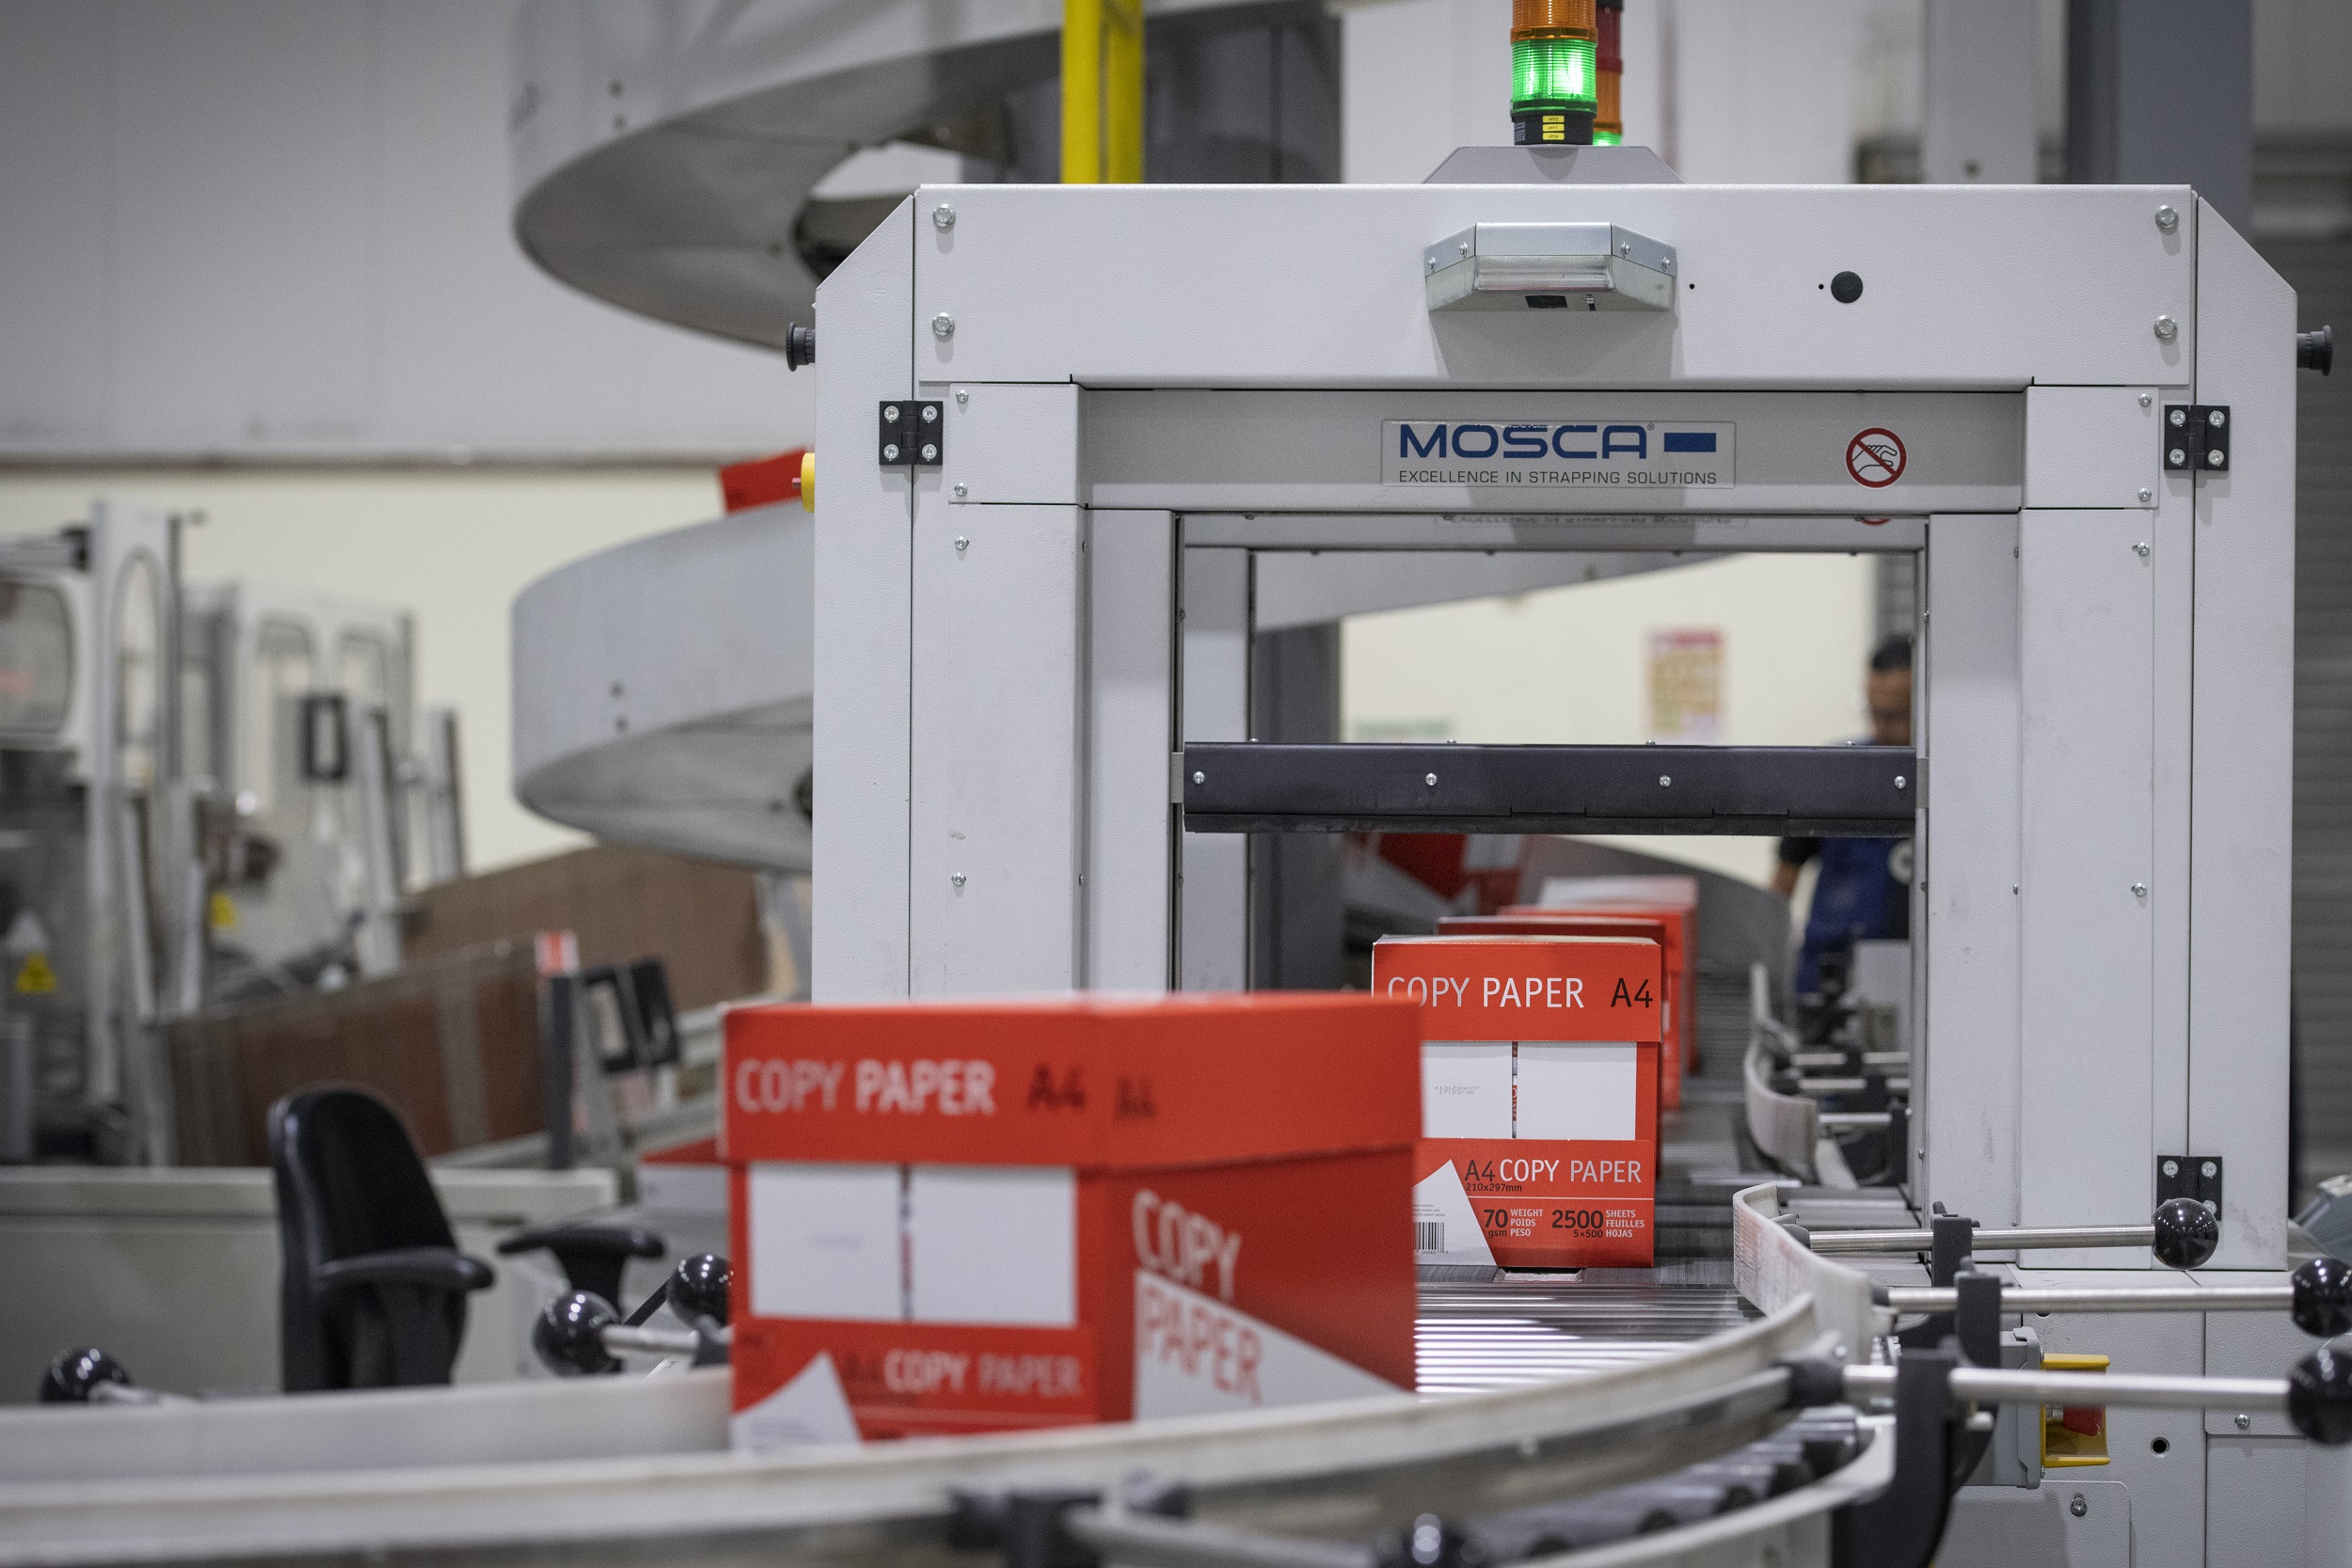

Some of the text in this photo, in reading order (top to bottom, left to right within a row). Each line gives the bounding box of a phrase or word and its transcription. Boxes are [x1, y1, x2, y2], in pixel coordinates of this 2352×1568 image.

[1399, 471, 1717, 484] EXCELLENCE IN STRAPPING SOLUTIONS
[1388, 976, 1654, 1008] COPY PAPER A4
[735, 1057, 1087, 1117] COPY PAPER A4
[1464, 1159, 1642, 1183] A4 COPY PAPER
[1466, 1182, 1523, 1192] 210x297mm
[1484, 1209, 1544, 1228] 70 WEIGHT
[1510, 1219, 1536, 1227] POIDS
[1552, 1210, 1636, 1229] 2500 SHEETS
[1605, 1220, 1645, 1228] FEUILLES
[1488, 1228, 1531, 1239] gsm PESO
[1605, 1228, 1633, 1238] HOJAS
[1132, 1189, 1242, 1306] COPY
[1134, 1285, 1264, 1407] PAPER
[883, 1349, 970, 1394] COPY
[978, 1353, 1081, 1398] PAPER
